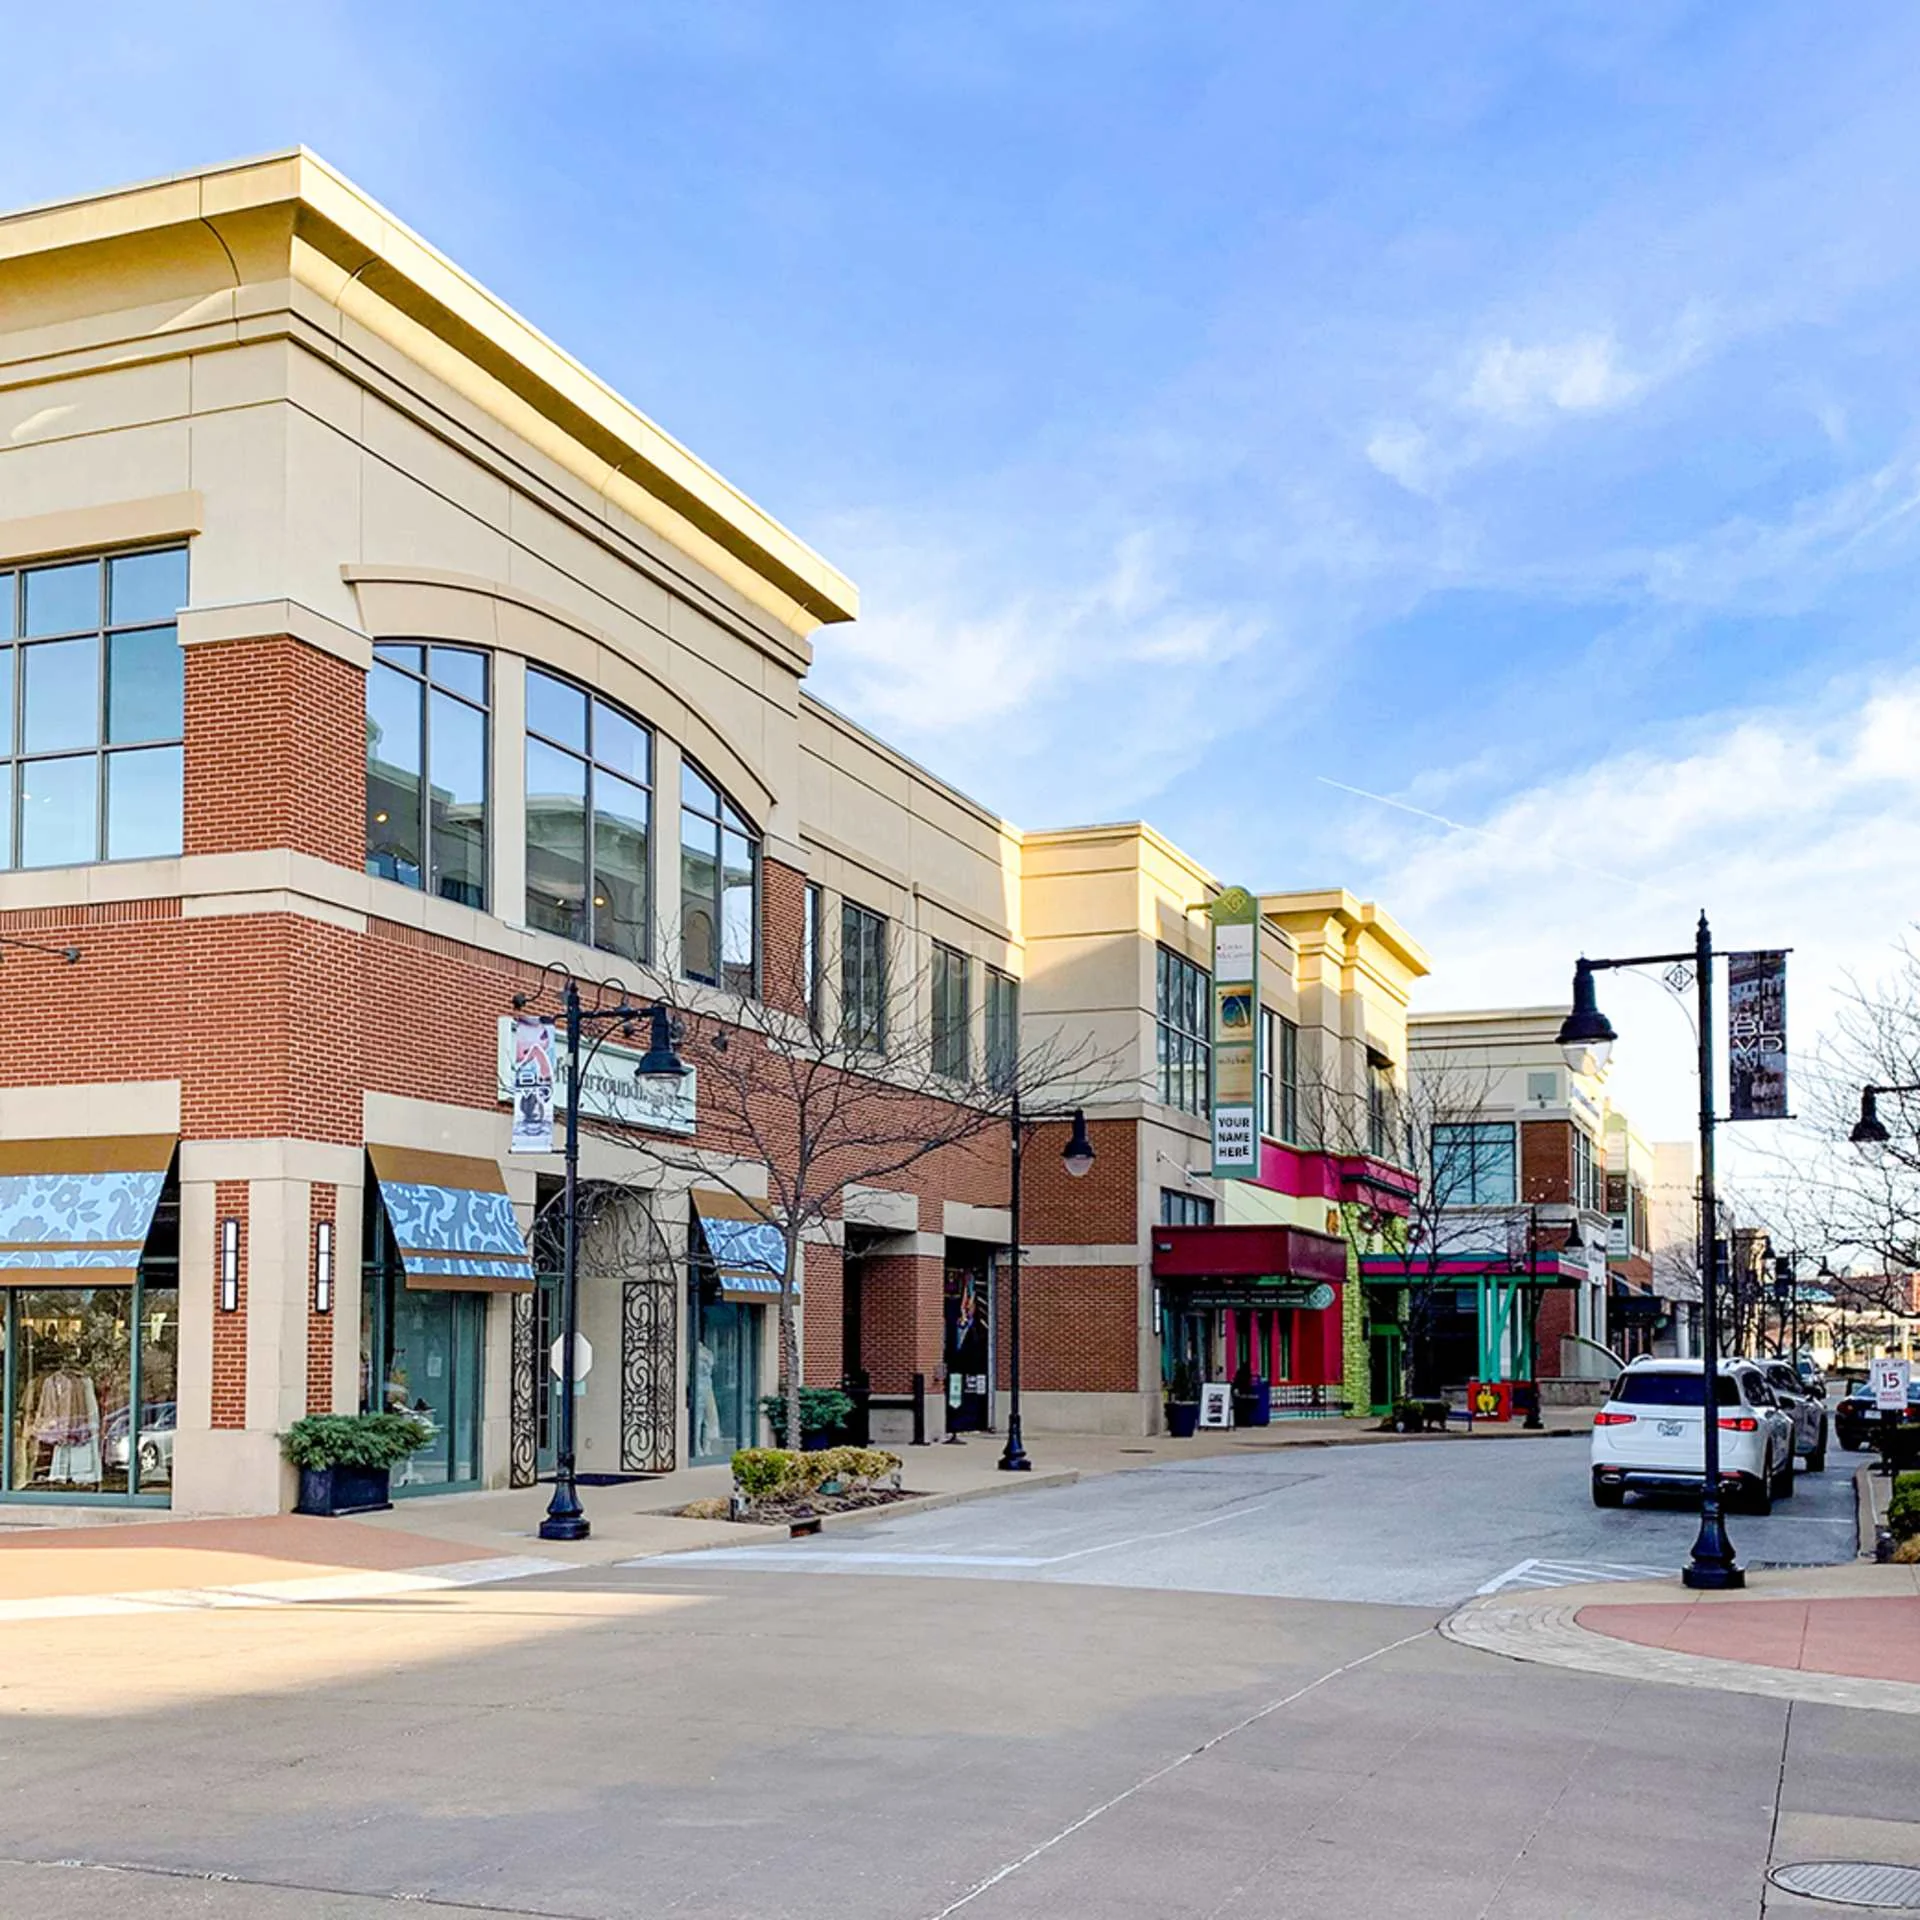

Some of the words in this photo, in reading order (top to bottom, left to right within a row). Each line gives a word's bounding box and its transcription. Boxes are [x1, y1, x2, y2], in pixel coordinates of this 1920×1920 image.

[1218, 1117, 1250, 1128] YOUR
[1218, 1132, 1250, 1142] NAME
[1219, 1145, 1249, 1157] HERE
[1882, 1372, 1900, 1389] 15
